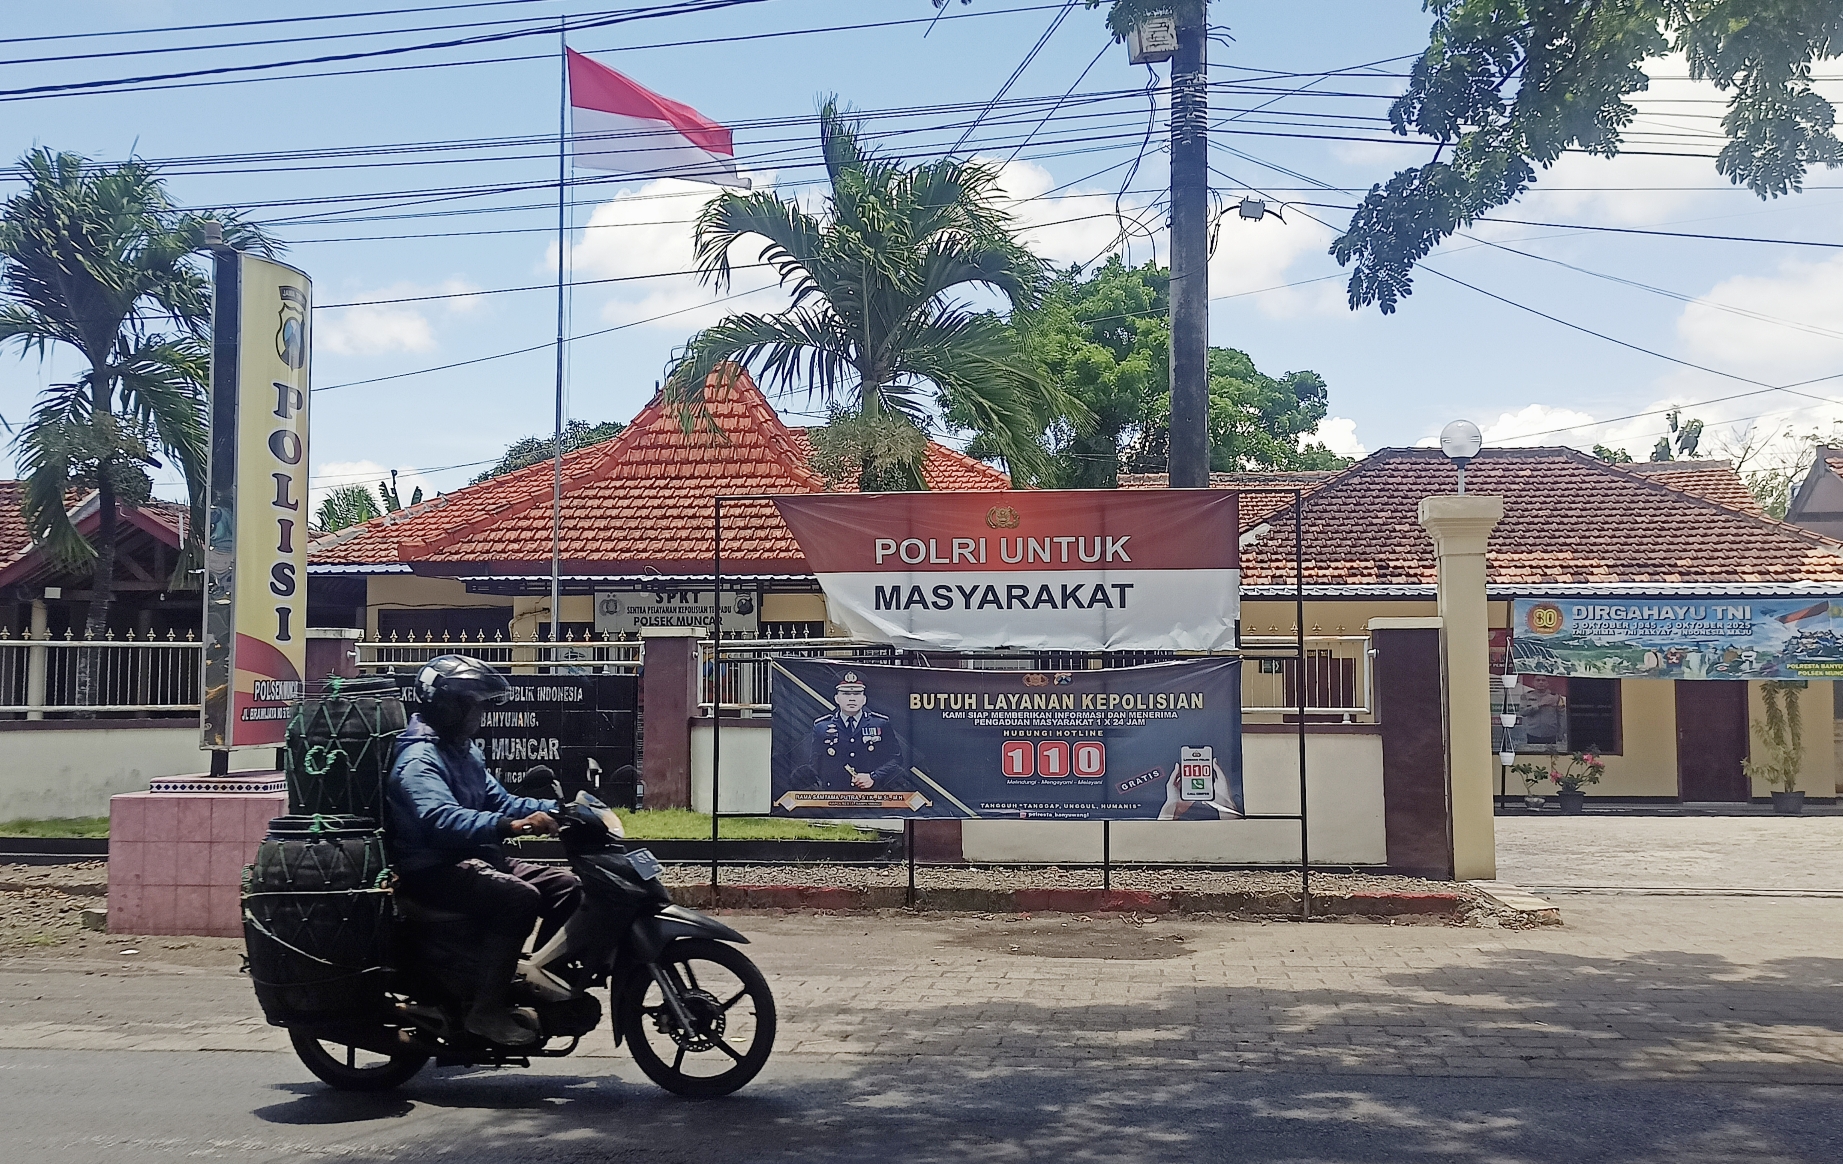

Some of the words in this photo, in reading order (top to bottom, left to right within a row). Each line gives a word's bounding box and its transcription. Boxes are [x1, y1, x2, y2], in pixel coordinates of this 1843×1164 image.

[269, 381, 304, 642] POLISI
[874, 536, 987, 566] POLRI
[1000, 534, 1133, 565] UNTUK
[655, 592, 701, 604] SPKT
[874, 581, 1134, 612] MASYARAKAT
[626, 607, 647, 615] SENTRA
[647, 606, 677, 615] PELAYANAN
[678, 606, 708, 615] KEPOLISIAN
[708, 606, 732, 614] TEADU
[1533, 608, 1558, 628] 80
[1572, 605, 1707, 621] DIRGAHAYU
[1711, 605, 1752, 621] TNI
[633, 616, 674, 626] POLSEK
[254, 681, 286, 702] POLSEK
[537, 686, 583, 702] INDONESIA
[910, 693, 977, 711] BUTUH
[983, 693, 1075, 711] LAYANAN
[1081, 692, 1205, 711] KEPOLISIAN
[942, 711, 966, 719] KAMI
[967, 711, 989, 719] SIAP
[990, 711, 1053, 719] MEMBERIKAN
[1054, 711, 1105, 719] INFORMASI
[1107, 711, 1126, 719] DAN
[1128, 711, 1178, 719] MENERIMA
[974, 718, 1030, 727] PENGADUAN
[1032, 718, 1094, 727] MASYARAKAT
[1096, 718, 1102, 726] 1
[1103, 718, 1111, 726] X
[1112, 718, 1124, 726] 24
[1126, 718, 1146, 726] JAM
[1003, 730, 1053, 738] HUBUNGI
[1056, 730, 1104, 738] HOTLINE
[491, 738, 561, 761] MUNCAR
[1006, 746, 1102, 775] 110
[1184, 765, 1210, 777] 110
[1006, 779, 1037, 787] Melindungi
[1040, 779, 1074, 787] Mengayomi
[1077, 779, 1103, 787] Melayani
[1120, 769, 1160, 791] GRATIS
